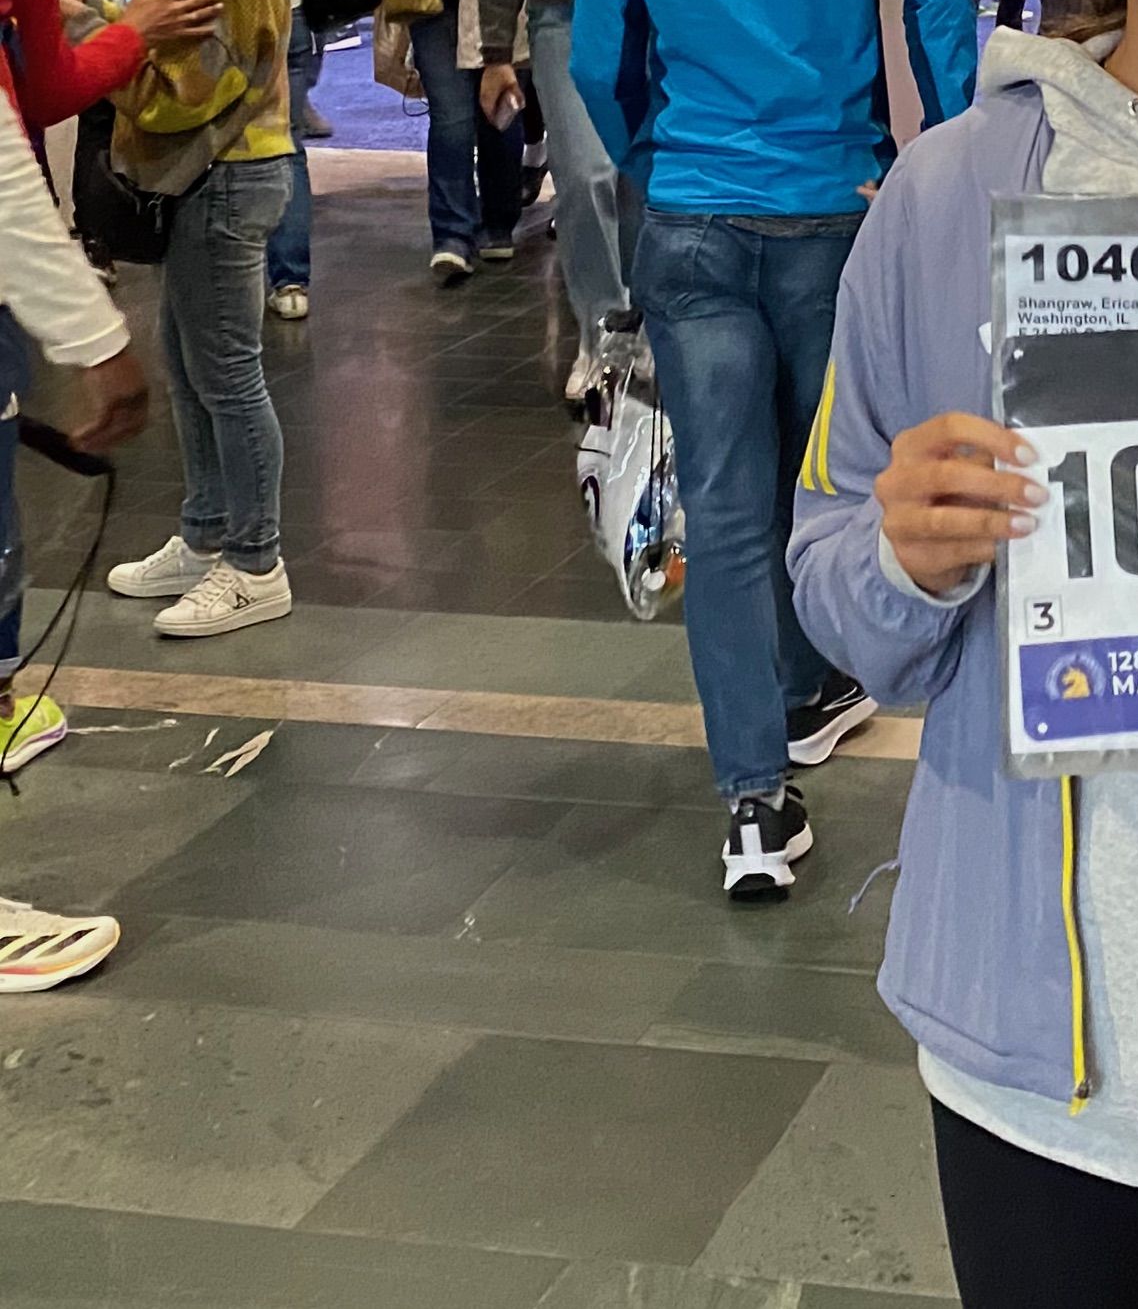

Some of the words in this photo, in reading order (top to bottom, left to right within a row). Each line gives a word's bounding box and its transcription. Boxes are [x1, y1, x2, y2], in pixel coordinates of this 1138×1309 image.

[1018, 297, 1097, 312] Shangraw,
[1102, 297, 1138, 309] Erica
[1018, 311, 1112, 326] Washington,
[1116, 312, 1130, 324] IL
[1032, 602, 1056, 630] 3
